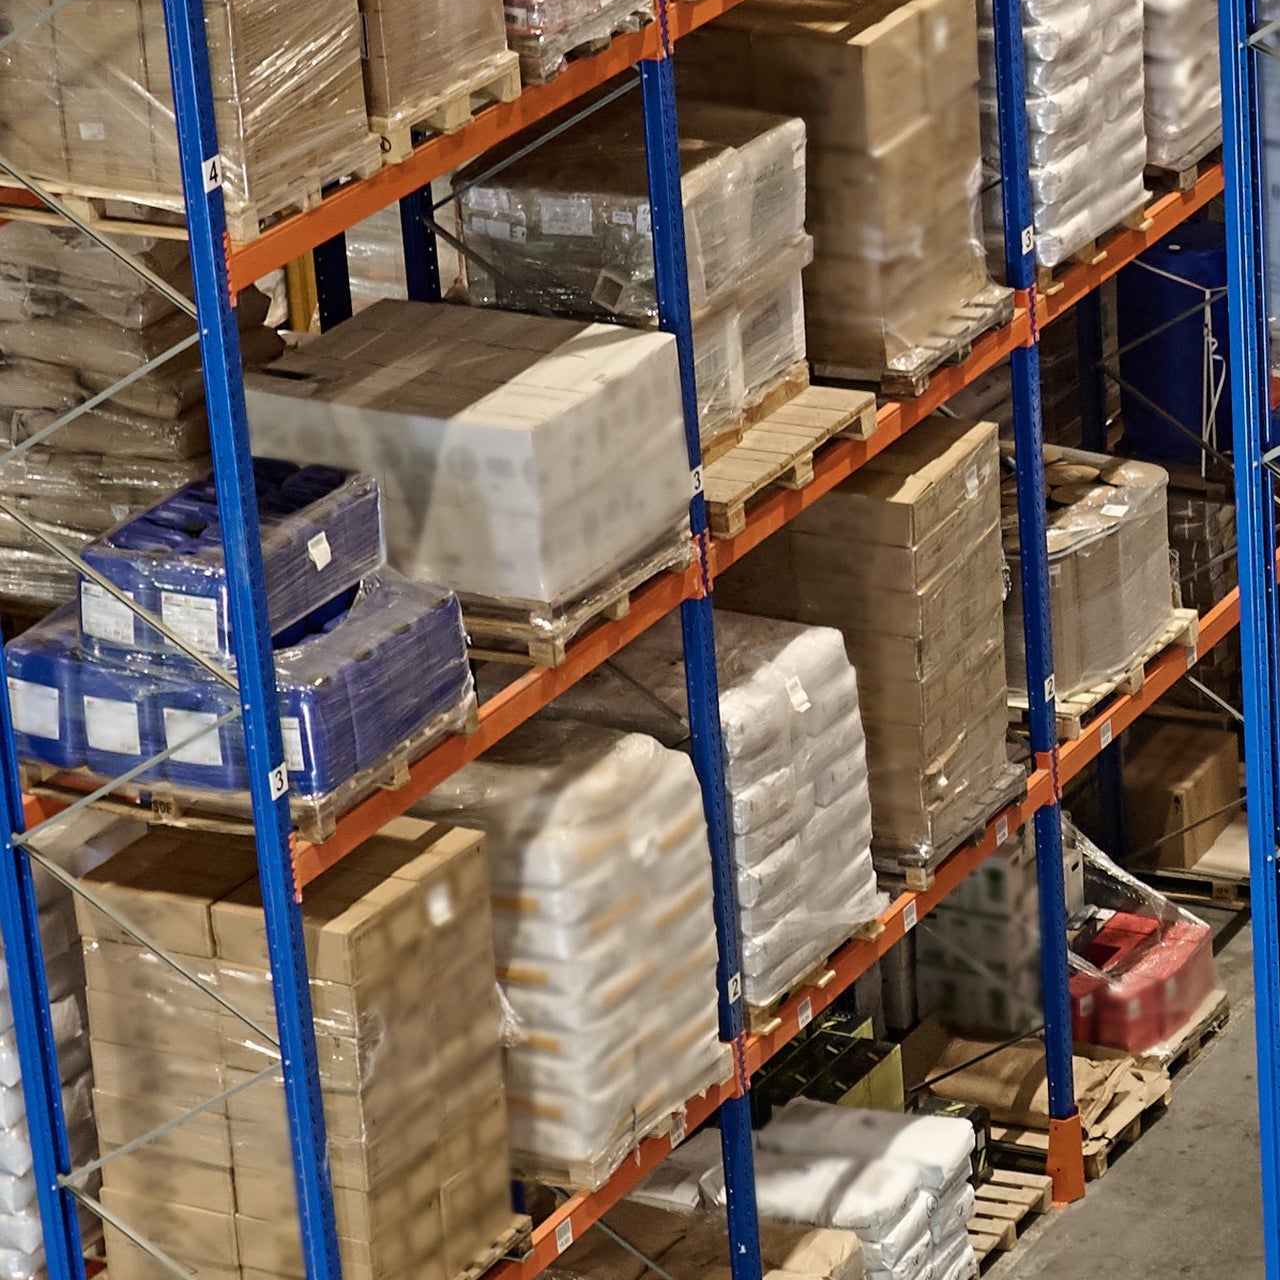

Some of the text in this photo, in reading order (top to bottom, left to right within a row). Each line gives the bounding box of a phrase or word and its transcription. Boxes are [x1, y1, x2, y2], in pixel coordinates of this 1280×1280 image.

[209, 160, 219, 183] 4
[1025, 230, 1032, 248] 3
[693, 470, 701, 490] 3
[1047, 678, 1054, 699] 2
[275, 770, 284, 792] 3
[732, 977, 739, 997] 2
